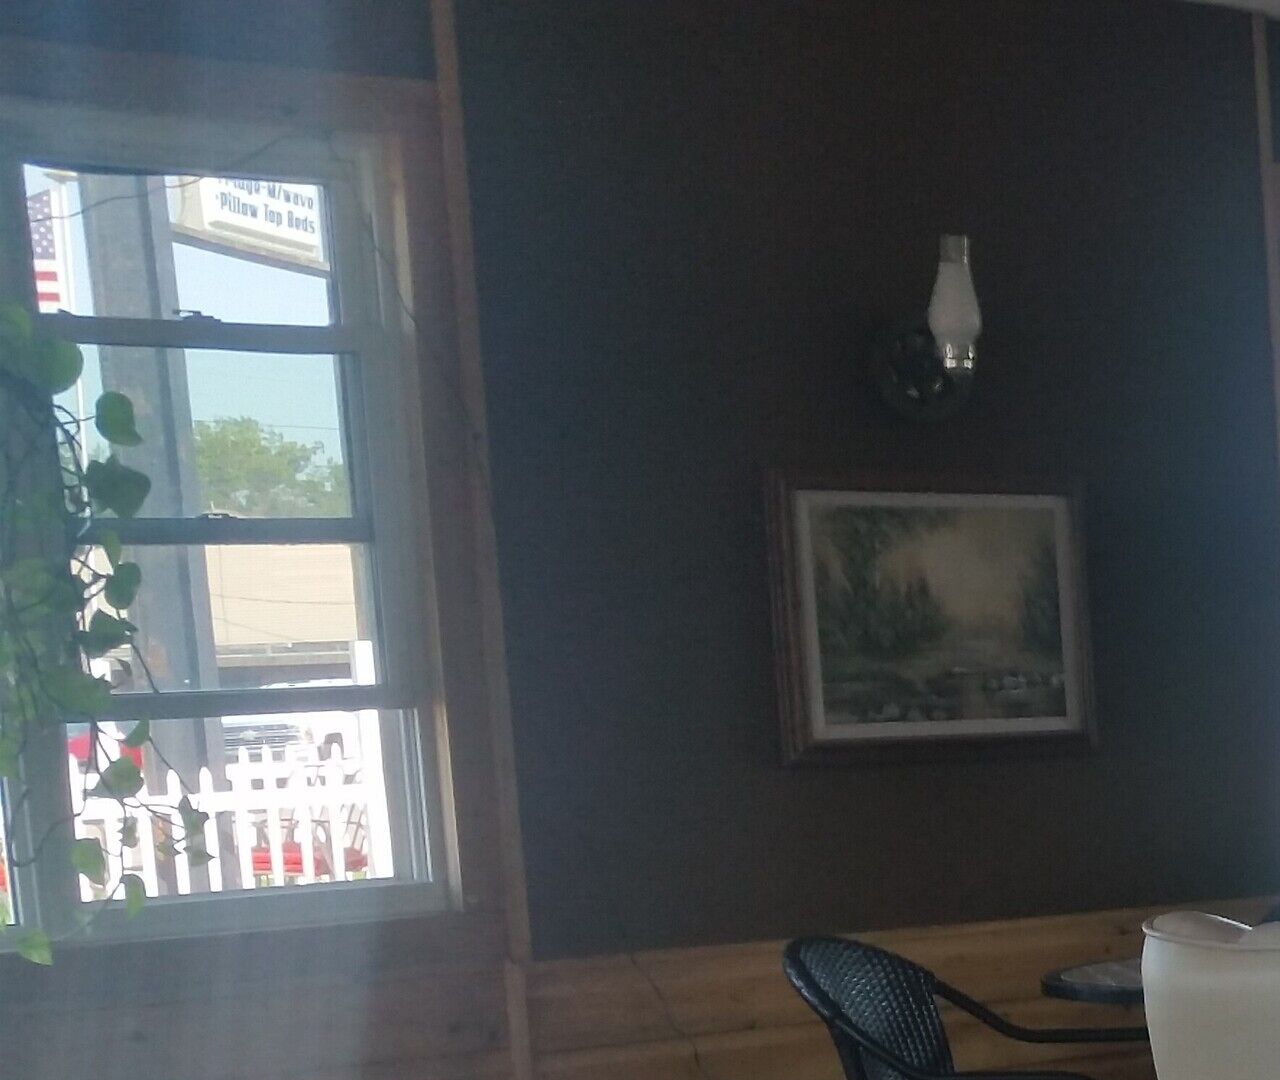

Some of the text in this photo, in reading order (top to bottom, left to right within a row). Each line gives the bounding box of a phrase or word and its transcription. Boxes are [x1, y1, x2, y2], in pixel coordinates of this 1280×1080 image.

[219, 191, 316, 234] Pillow Top Beds
